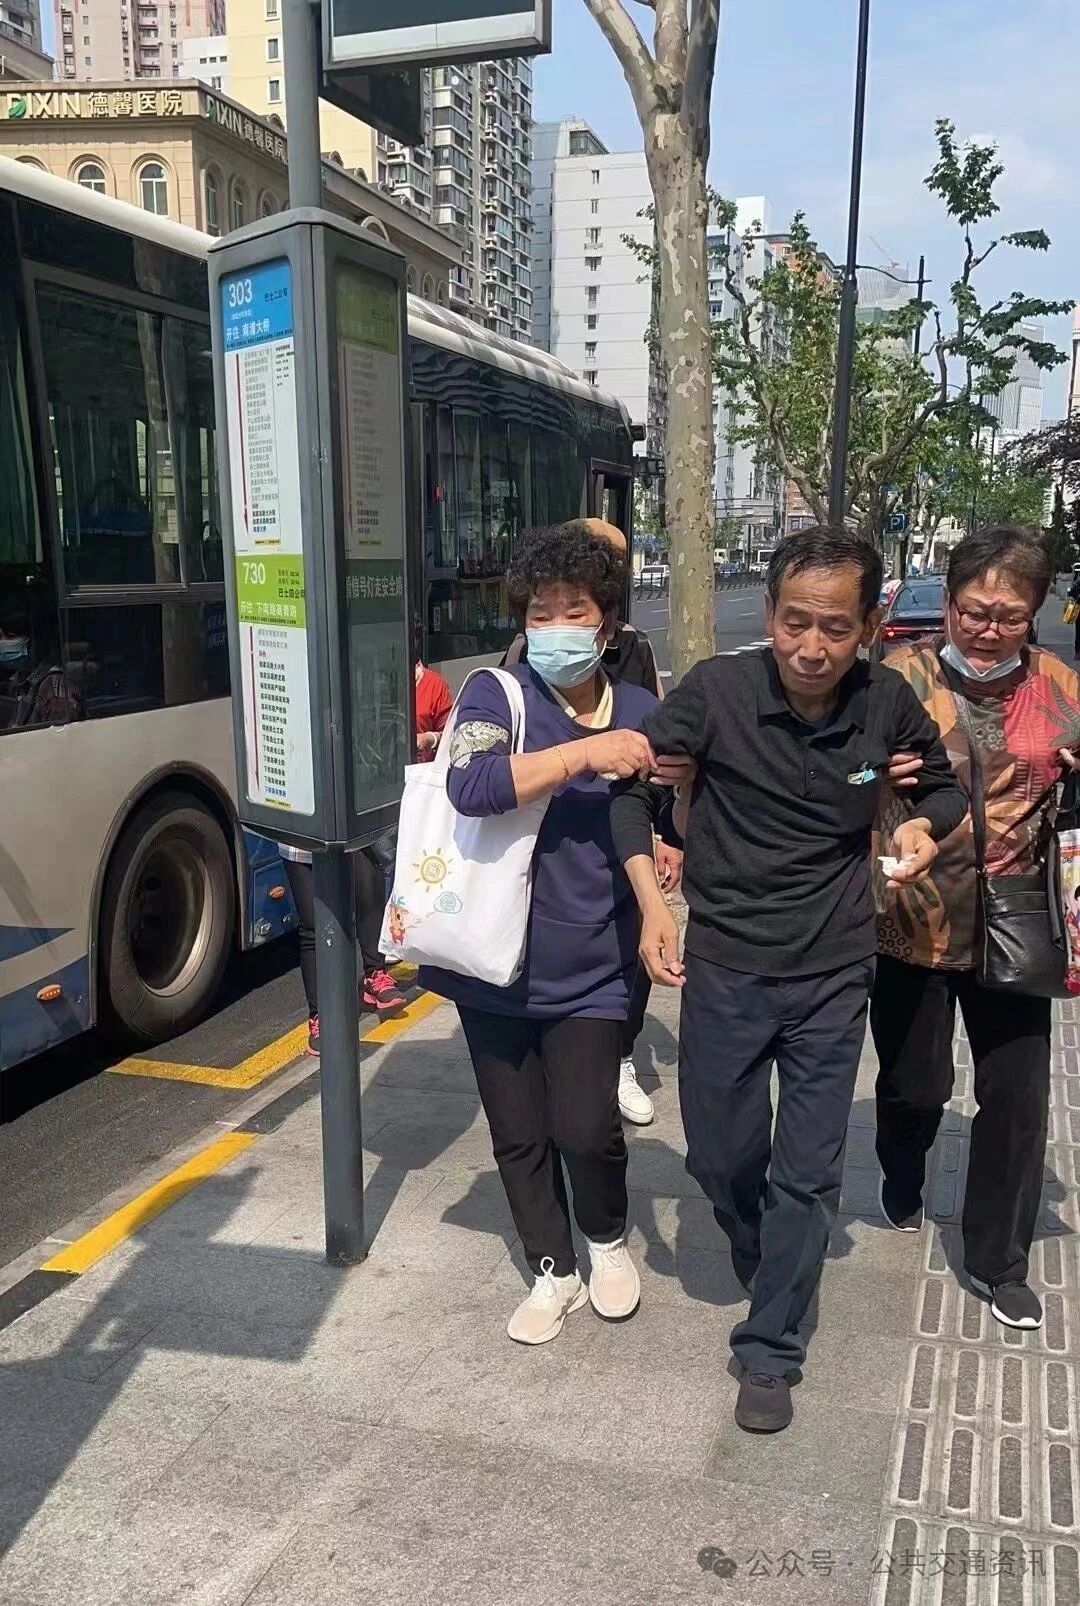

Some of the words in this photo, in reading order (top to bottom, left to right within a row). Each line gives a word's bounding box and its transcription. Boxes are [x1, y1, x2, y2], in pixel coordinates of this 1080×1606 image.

[88, 90, 183, 116] 德馨医院
[228, 279, 253, 308] 303
[890, 516, 901, 530] P
[242, 562, 266, 585] 730
